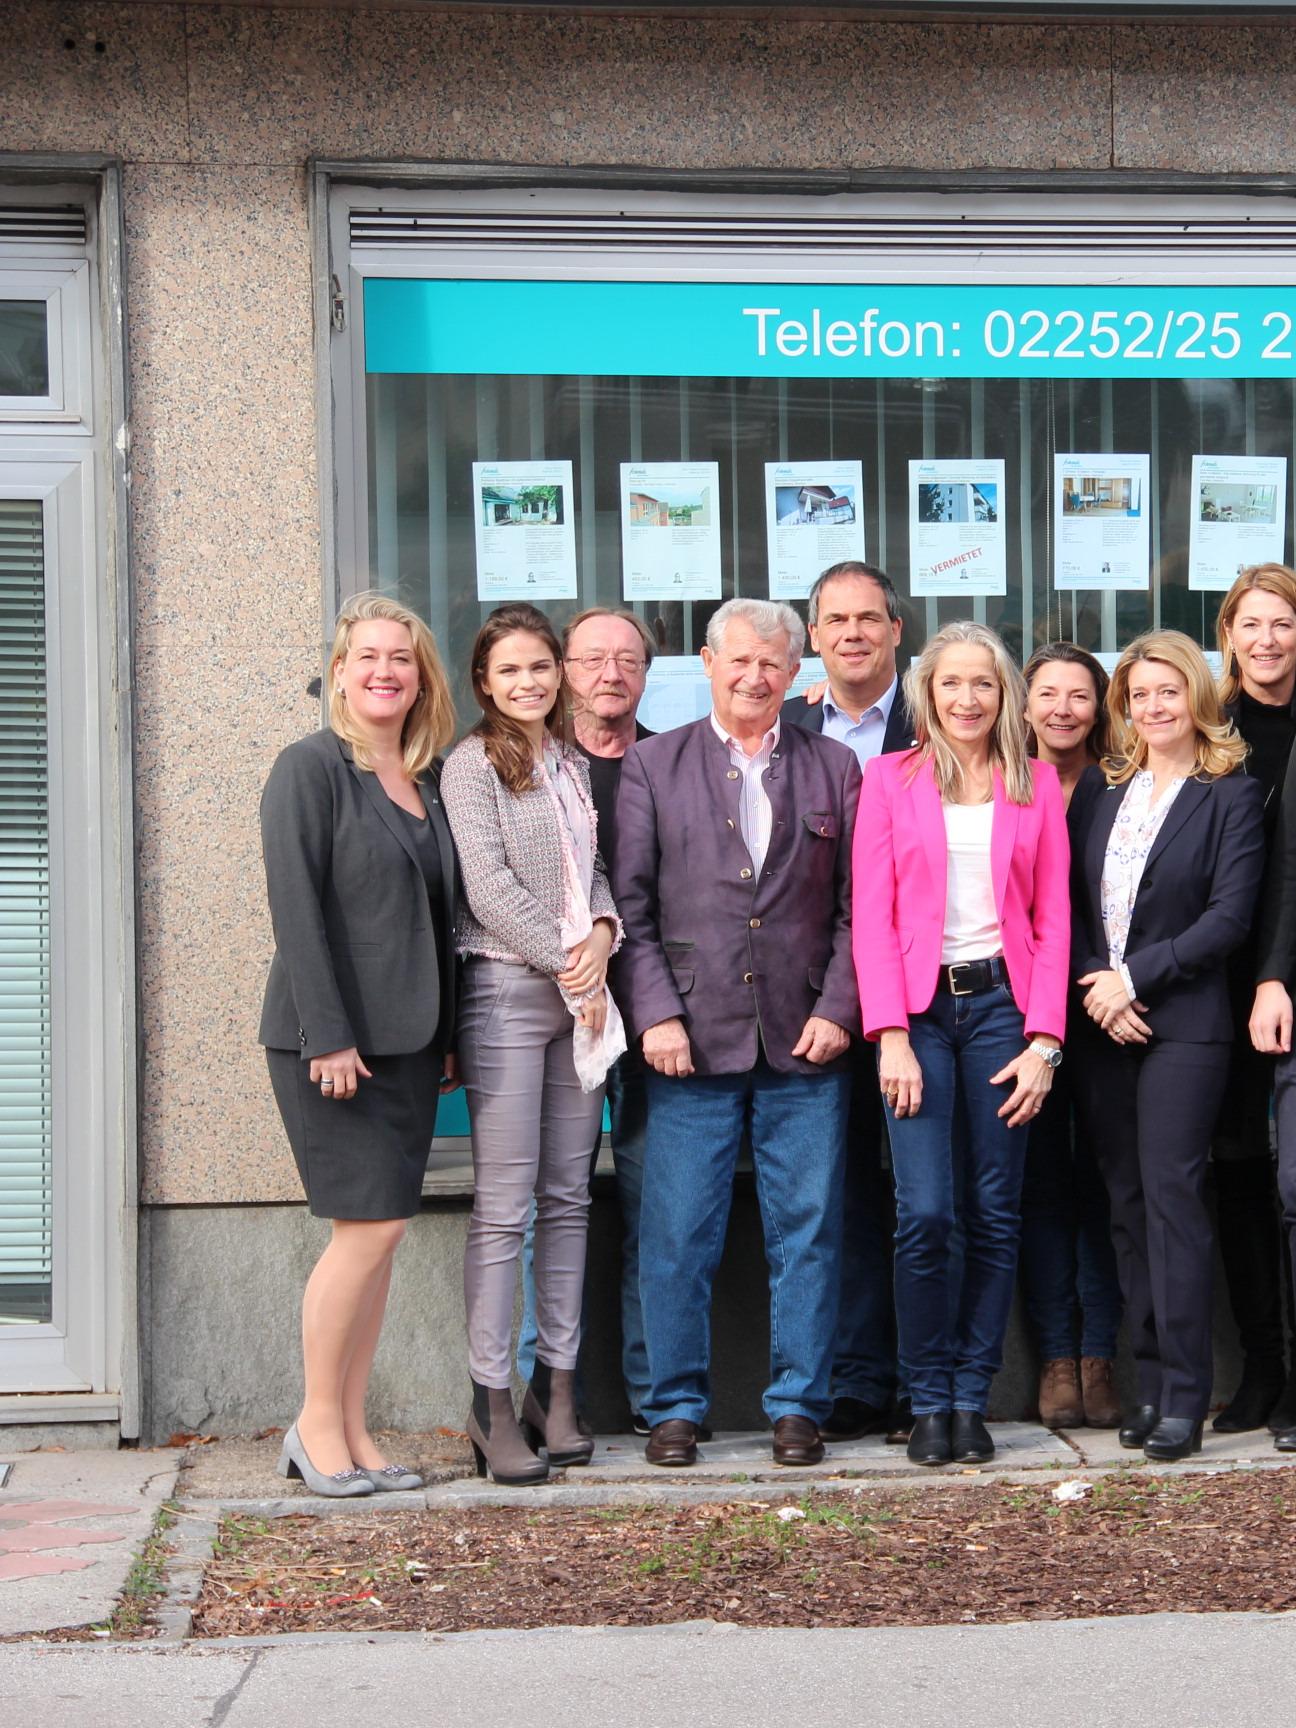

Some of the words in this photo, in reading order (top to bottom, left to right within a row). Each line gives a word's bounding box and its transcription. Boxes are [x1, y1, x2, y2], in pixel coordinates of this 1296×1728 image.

[742, 308, 961, 358] Telefon:
[984, 309, 1241, 360] 02252/25
[930, 547, 983, 576] VERMIETET
